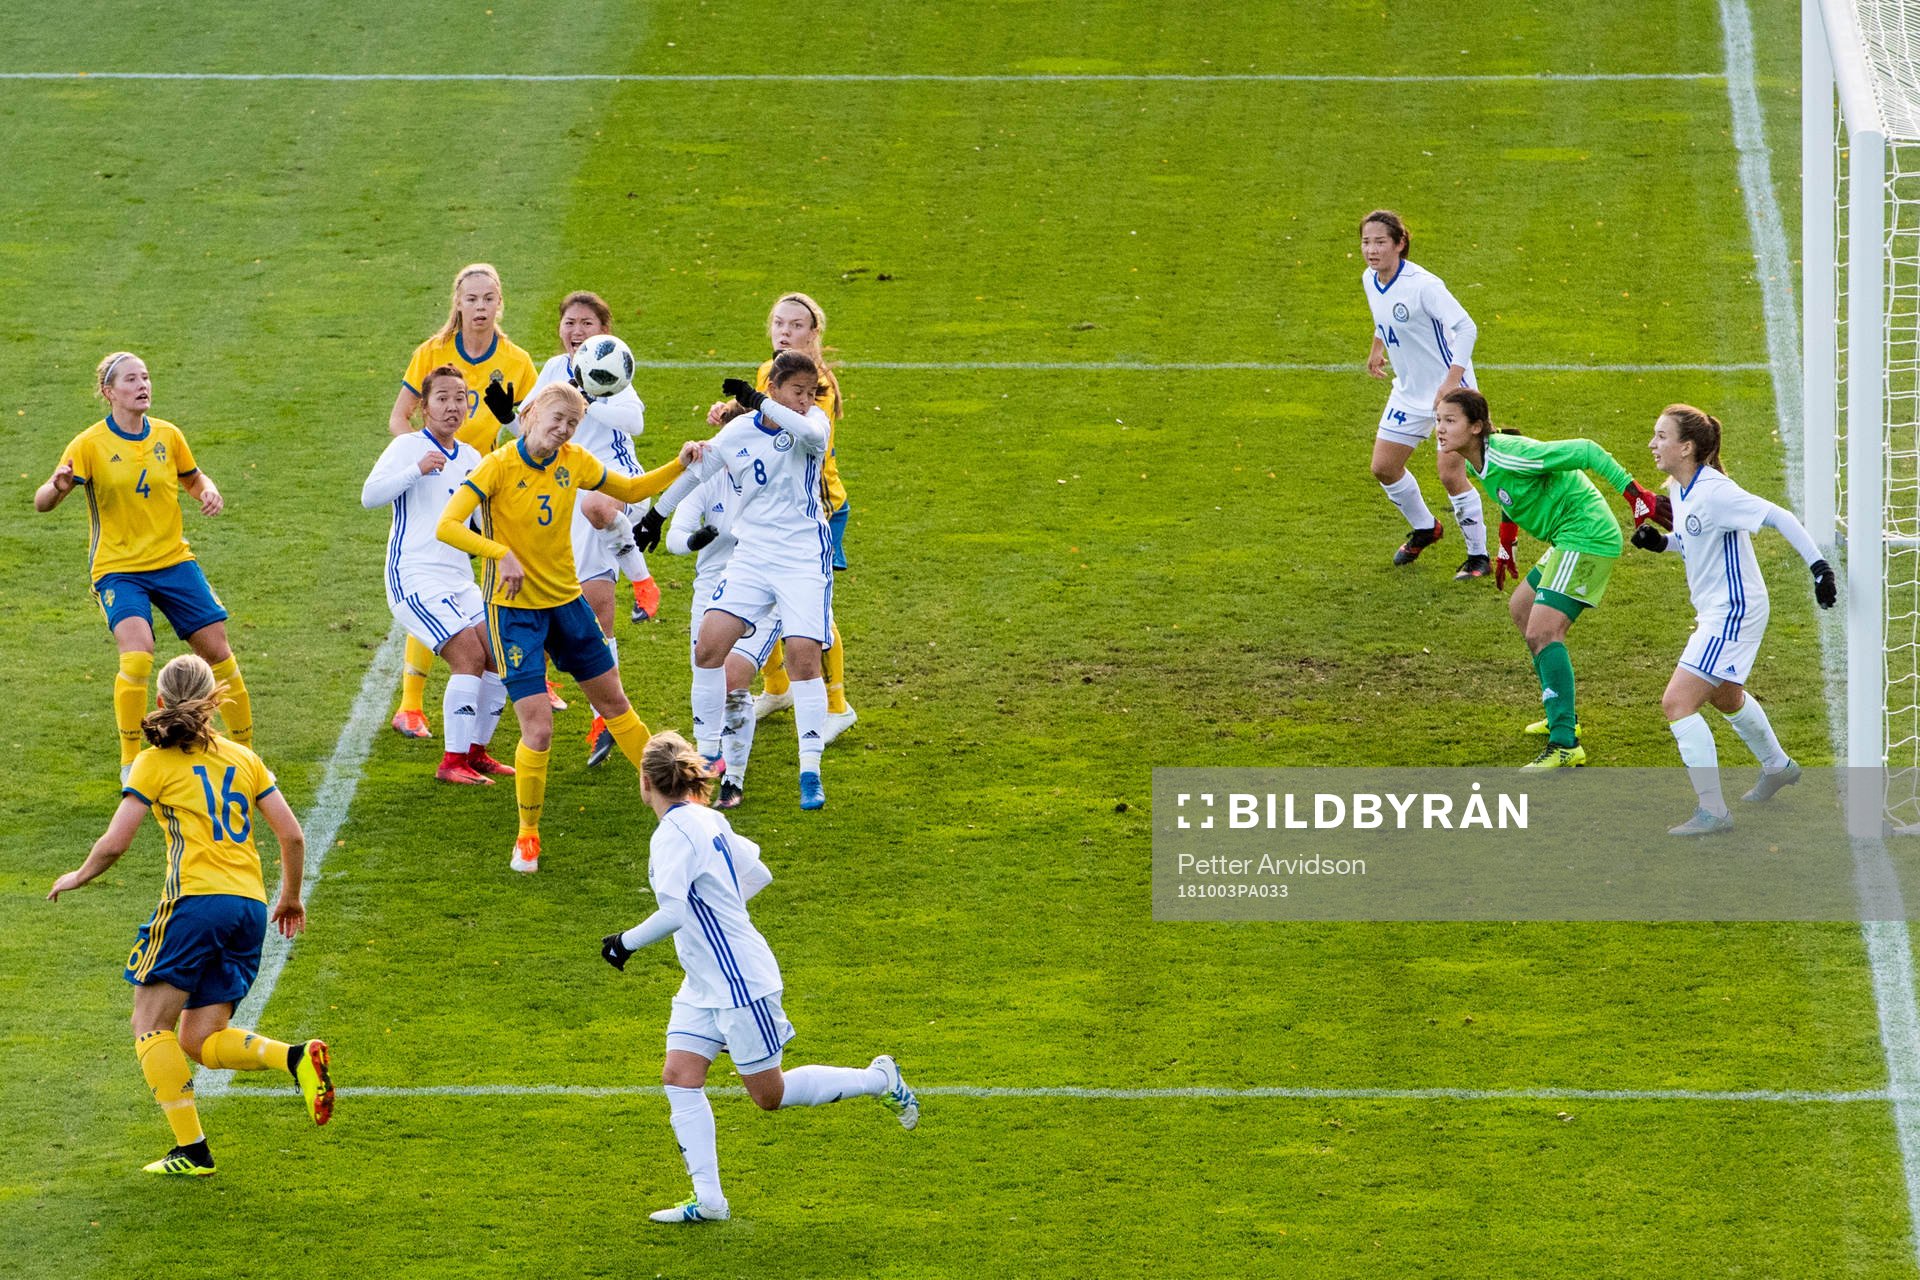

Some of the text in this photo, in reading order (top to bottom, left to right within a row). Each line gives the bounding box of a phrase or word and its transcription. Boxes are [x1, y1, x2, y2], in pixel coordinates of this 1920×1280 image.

[1378, 323, 1400, 348] 14
[1387, 407, 1407, 426] 14
[135, 468, 151, 499] 4
[753, 458, 768, 486] 8
[537, 494, 553, 526] 3
[712, 578, 727, 601] 8
[192, 765, 251, 844] 16
